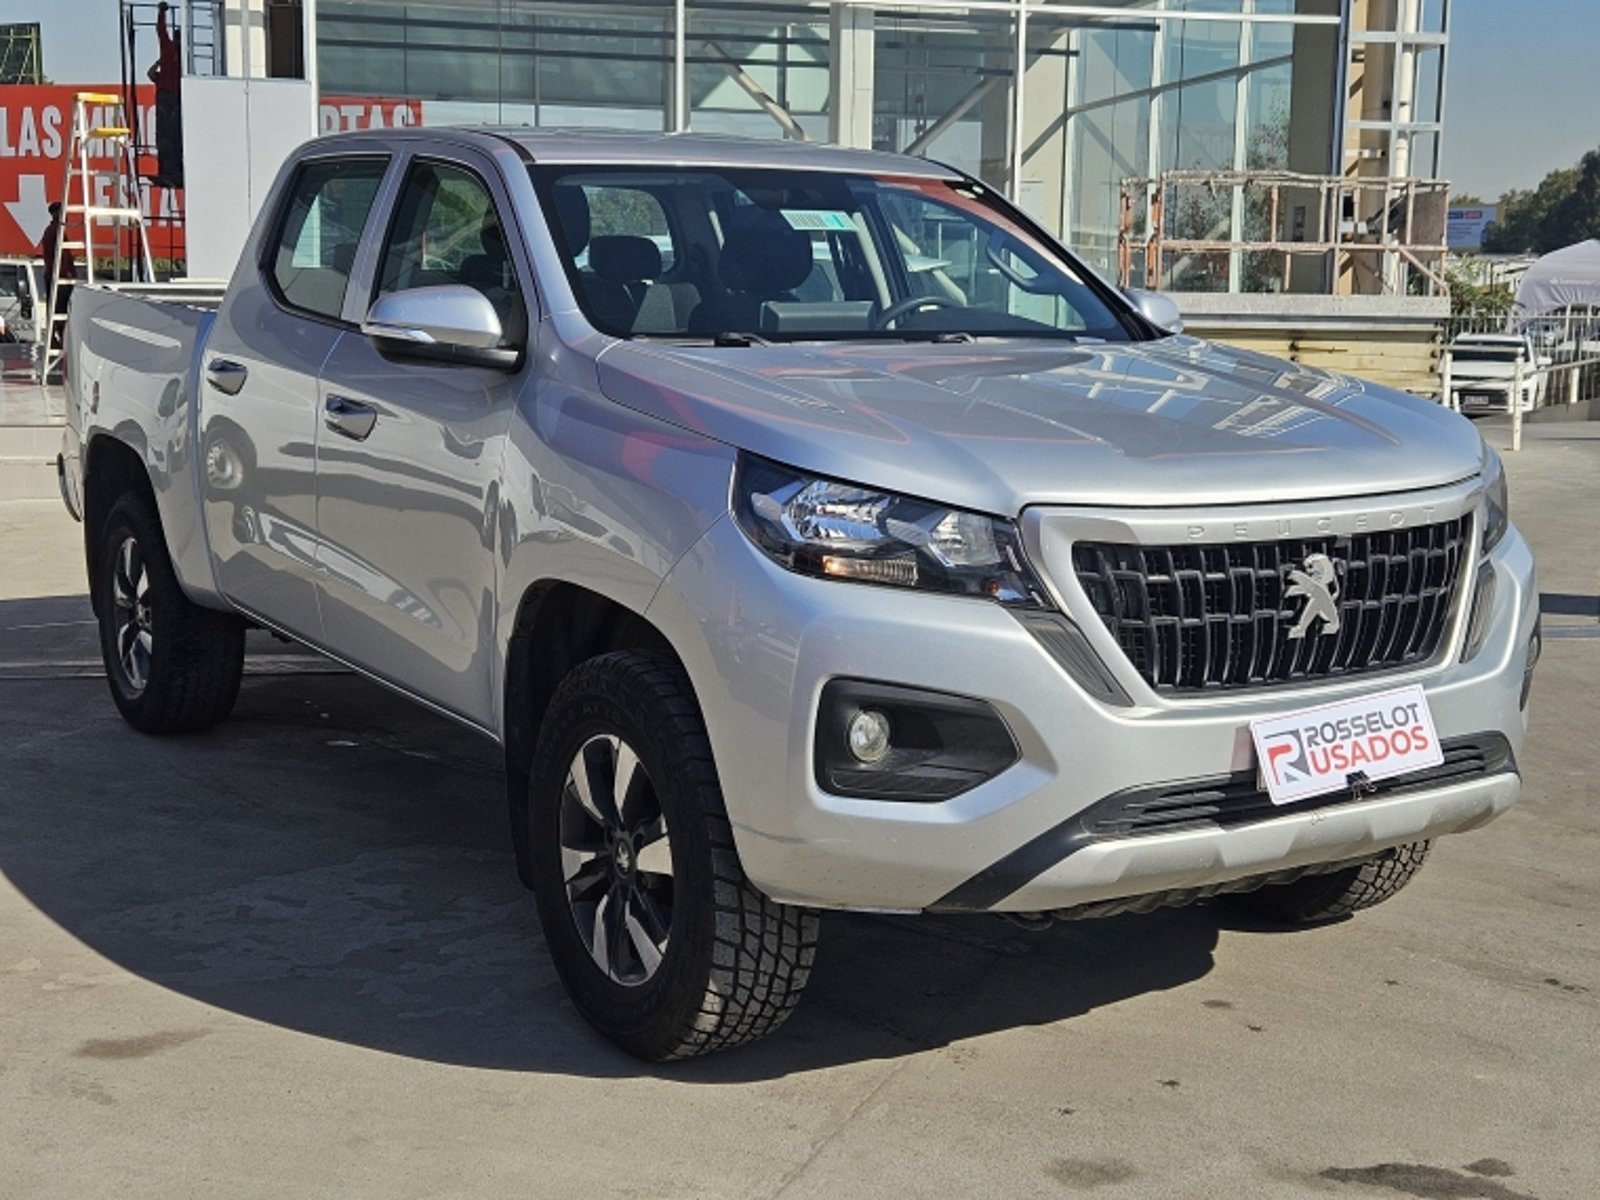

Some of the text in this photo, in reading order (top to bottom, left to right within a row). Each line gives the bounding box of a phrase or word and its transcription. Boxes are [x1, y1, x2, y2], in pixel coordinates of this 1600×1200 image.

[0, 106, 62, 158] LAS
[1187, 507, 1435, 541] PEUGEOT
[1304, 703, 1419, 748] ROSSELOT
[1310, 726, 1429, 775] USADOS
